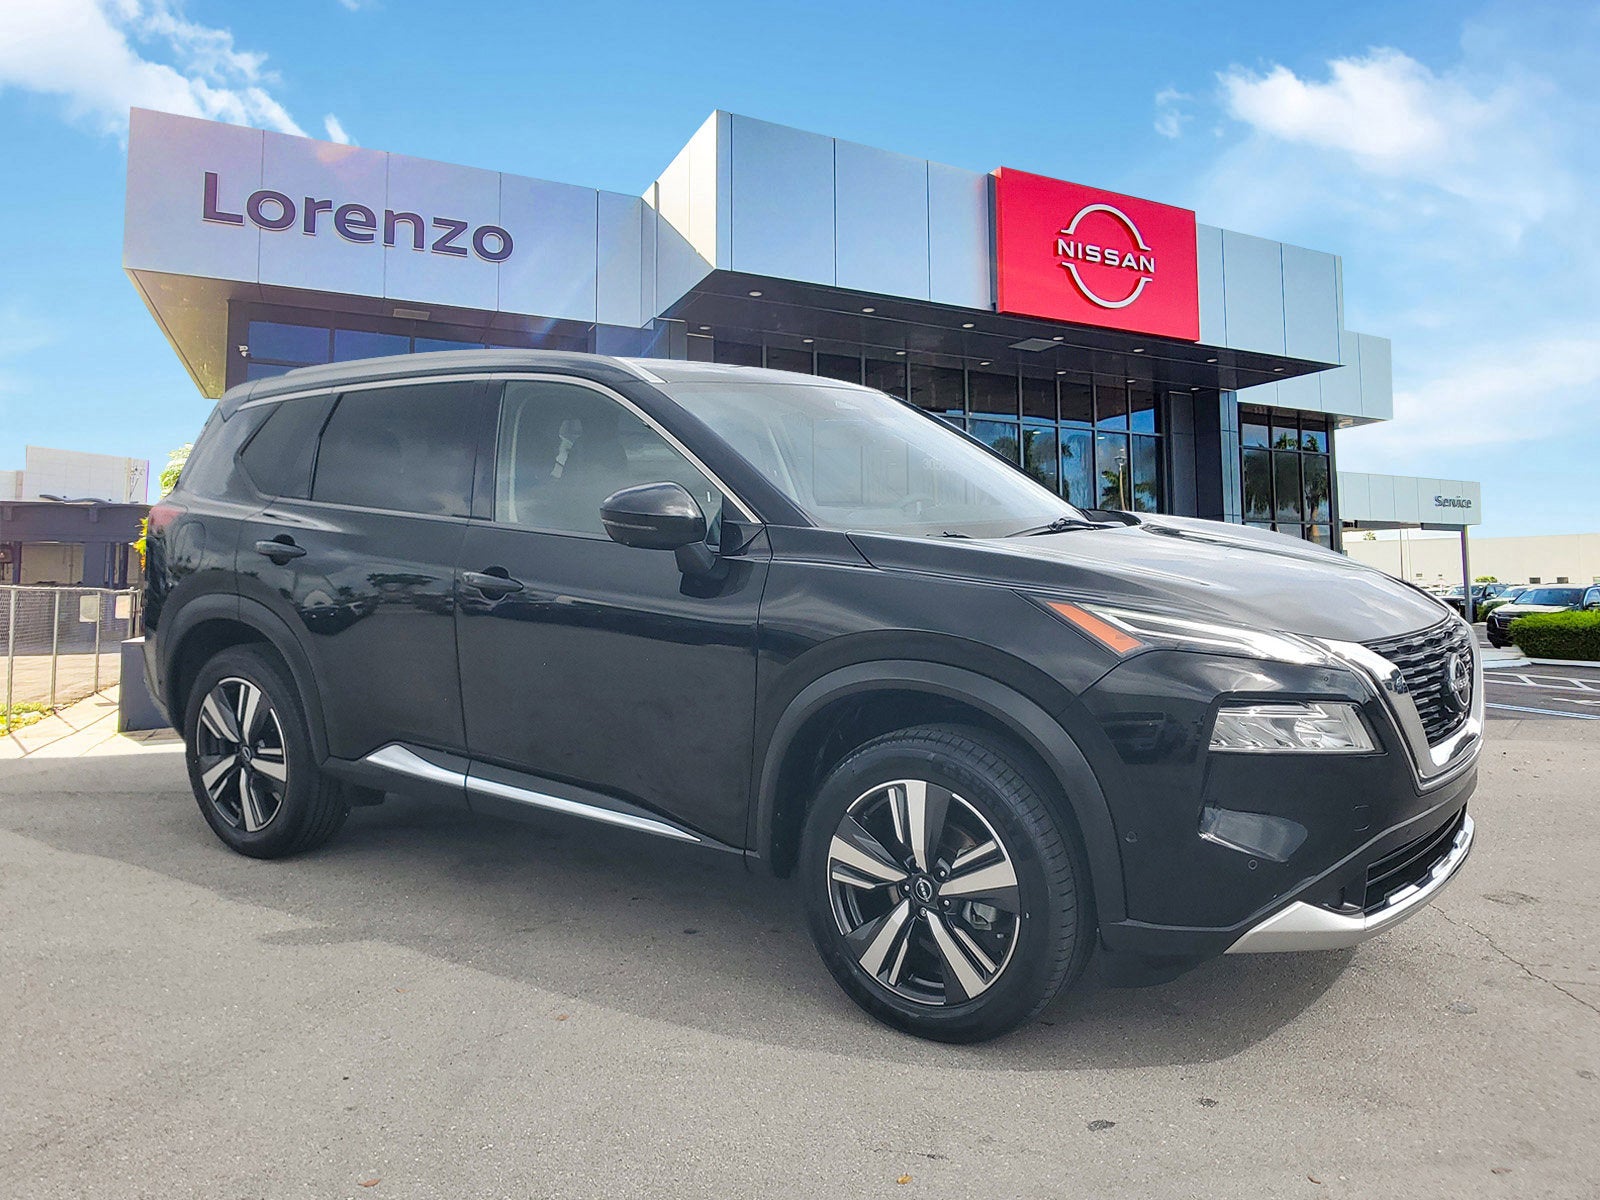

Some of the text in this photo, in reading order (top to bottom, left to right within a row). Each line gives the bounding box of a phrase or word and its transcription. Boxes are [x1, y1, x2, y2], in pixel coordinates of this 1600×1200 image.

[202, 171, 514, 262] Lorenzo
[1057, 238, 1155, 273] NISSAN
[1434, 495, 1472, 508] Service
